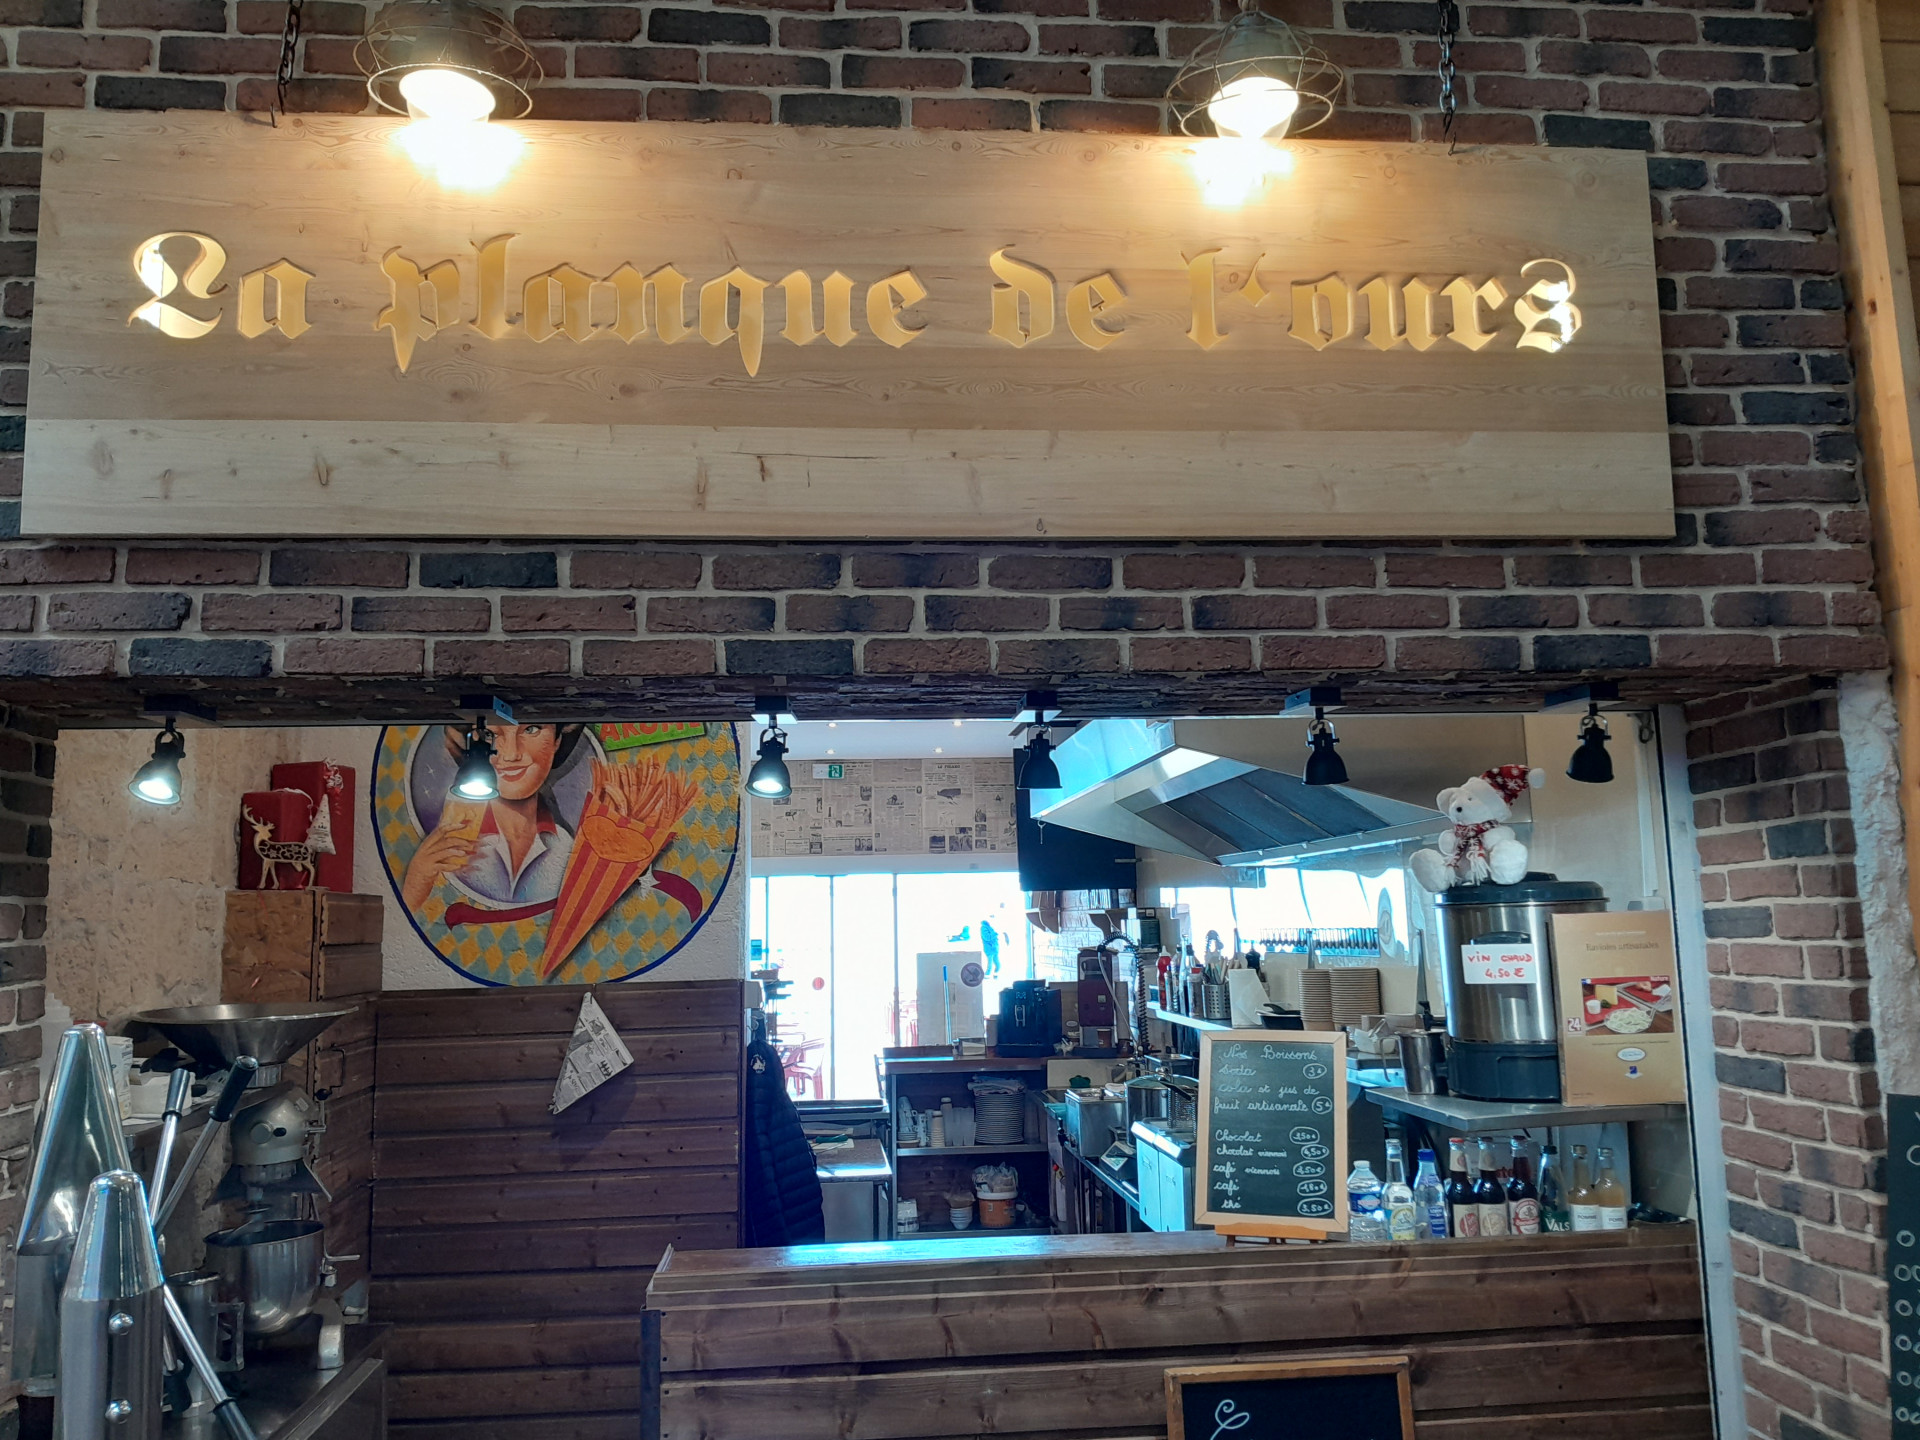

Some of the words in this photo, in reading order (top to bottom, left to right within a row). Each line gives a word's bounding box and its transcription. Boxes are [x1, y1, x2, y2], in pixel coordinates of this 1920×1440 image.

[130, 231, 315, 341] La
[374, 233, 929, 377] planque
[987, 244, 1127, 351] de
[1500, 953, 1533, 963] CHAUD
[1567, 1016, 1582, 1032] 24
[1223, 1043, 1248, 1059] Nos
[1260, 1044, 1318, 1060] Boissons
[1257, 1084, 1271, 1093] et
[1278, 1085, 1298, 1098] jus
[1303, 1084, 1320, 1095] de
[1213, 1096, 1240, 1114] fruit
[1215, 1129, 1263, 1143] Chocolat
[1213, 1161, 1237, 1178] café
[1213, 1179, 1240, 1196] café
[1221, 1197, 1242, 1209] thé
[1544, 1217, 1570, 1231] VALS
